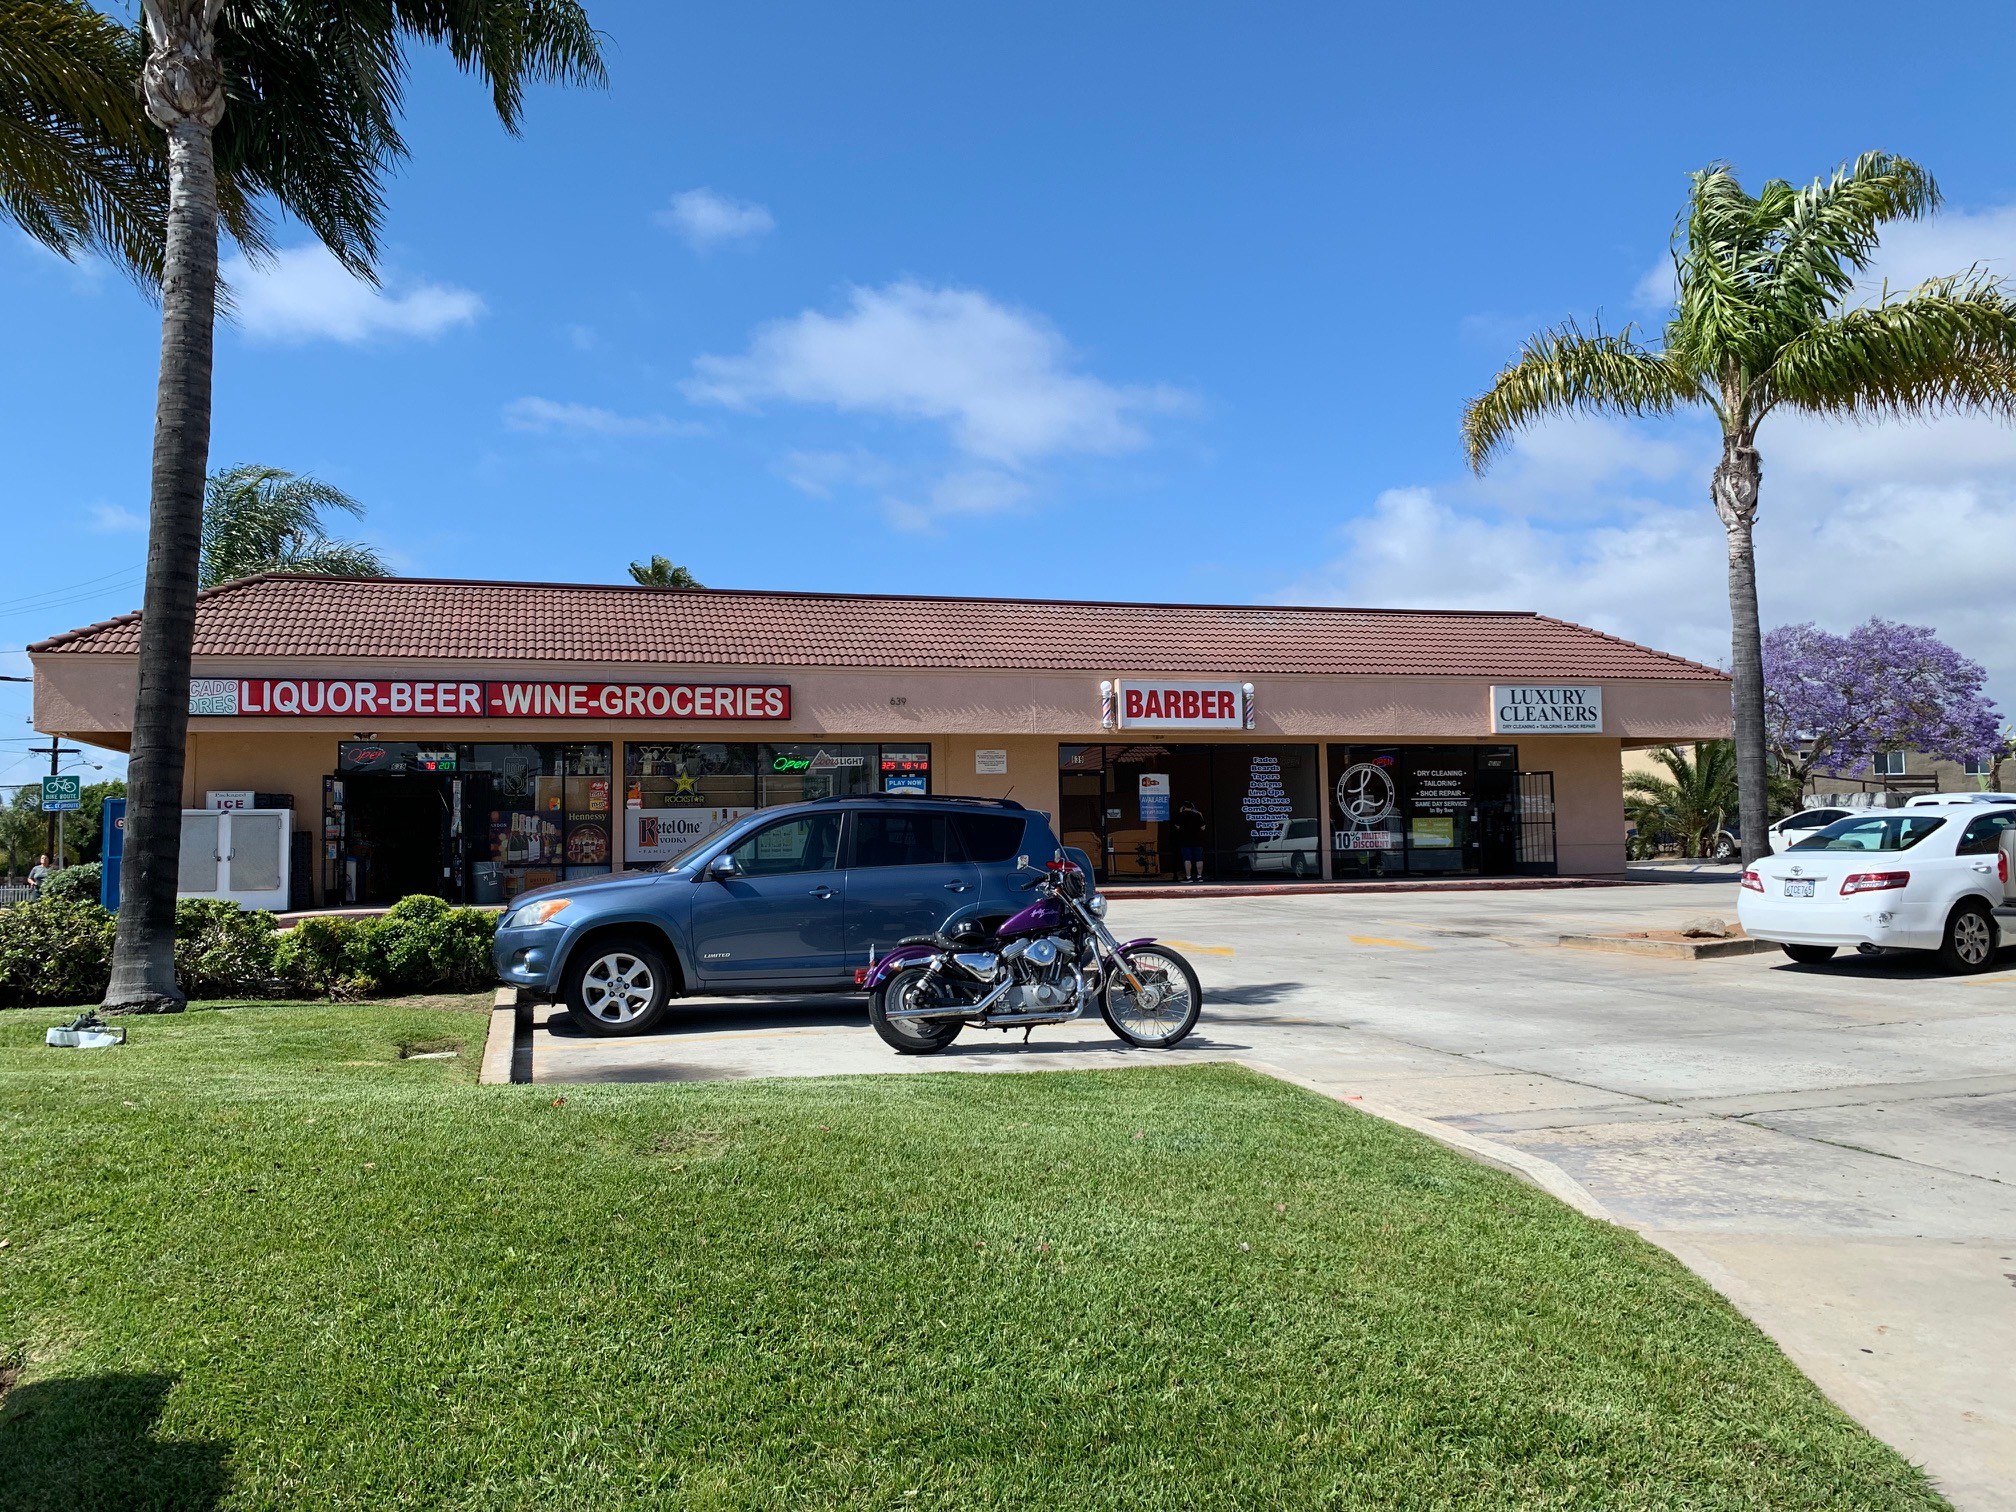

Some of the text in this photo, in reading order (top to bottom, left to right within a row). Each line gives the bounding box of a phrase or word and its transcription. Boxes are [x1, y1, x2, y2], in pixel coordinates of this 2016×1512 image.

[241, 681, 481, 714] LIQUOR-BEER
[889, 697, 907, 706] 639
[1125, 689, 1236, 719] BARBER
[1510, 689, 1586, 705] LUXURY
[1500, 705, 1598, 721] CLEANERS
[348, 748, 386, 762] Open
[774, 758, 810, 771] Open
[1251, 773, 1280, 781] Tapers
[1250, 781, 1282, 789] Designs
[217, 800, 244, 809] ICE
[569, 813, 606, 821] Hennessy
[677, 820, 700, 834] One
[1336, 832, 1360, 848] 10%
